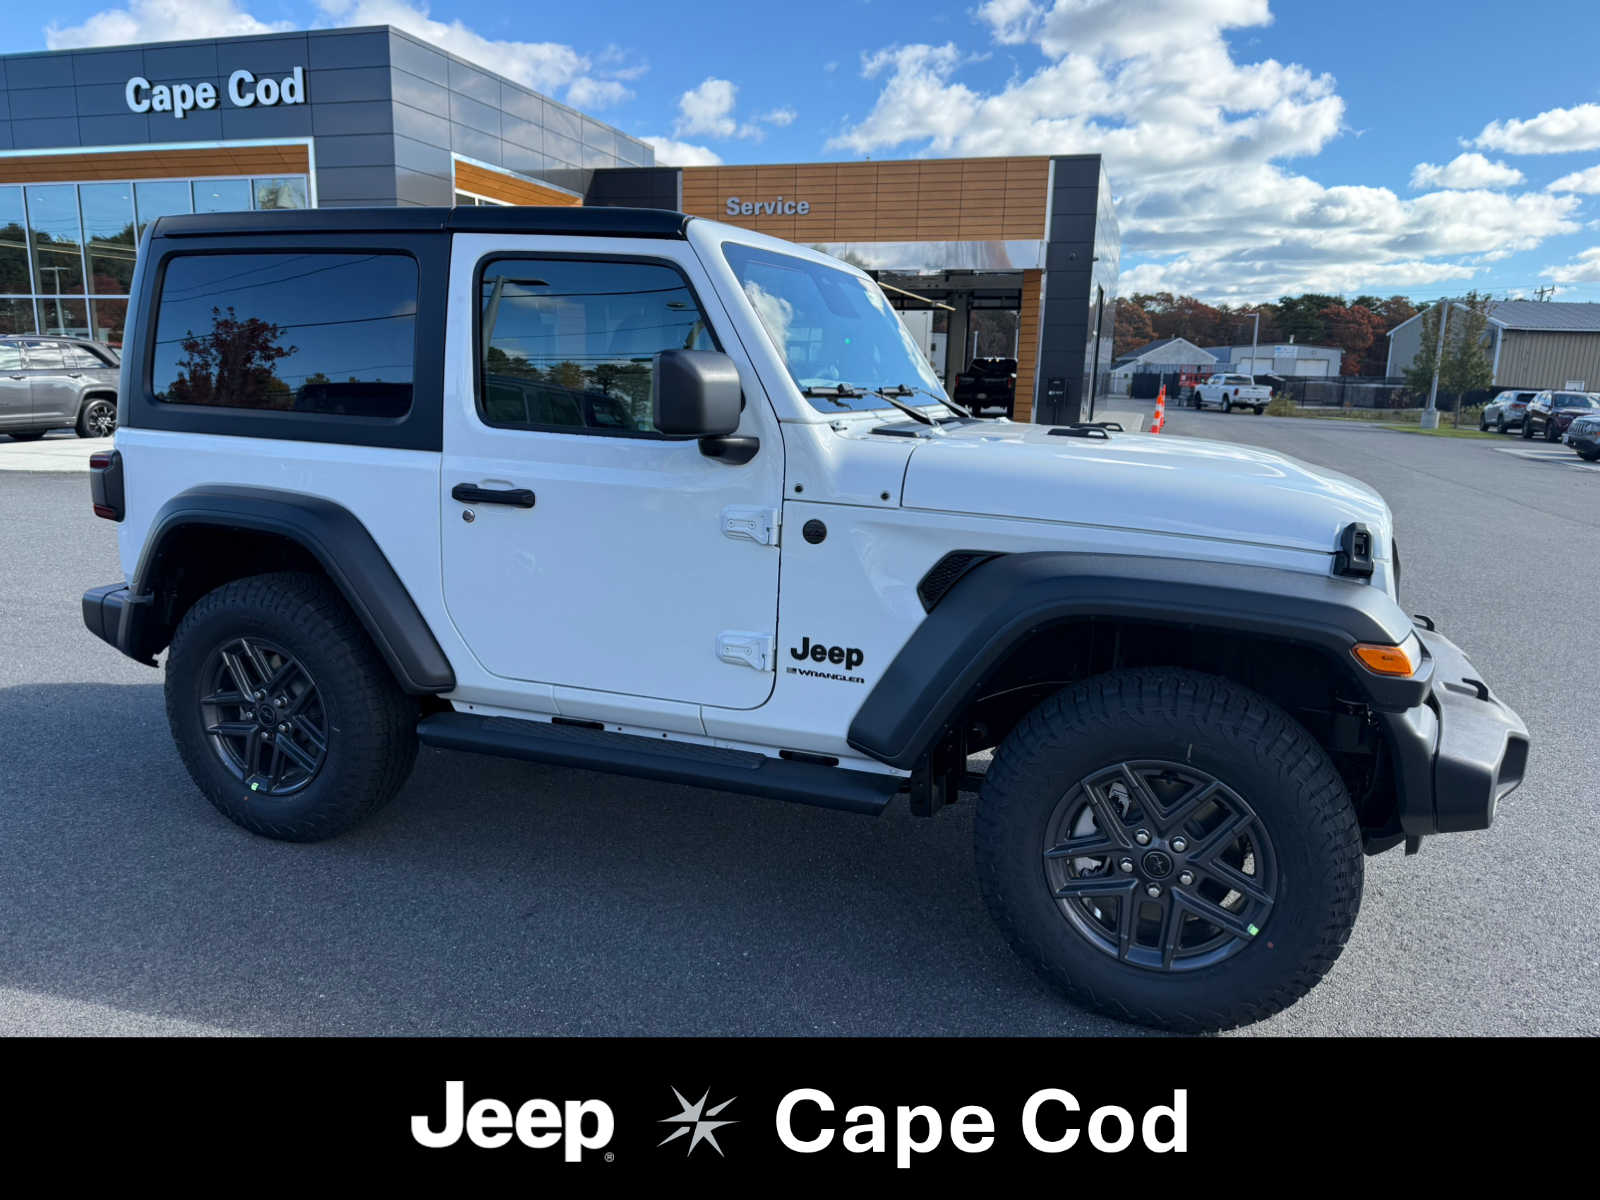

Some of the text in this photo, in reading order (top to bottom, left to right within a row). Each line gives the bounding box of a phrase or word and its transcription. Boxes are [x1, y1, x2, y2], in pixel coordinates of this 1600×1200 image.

[125, 66, 306, 119] Cape Cod
[726, 196, 810, 216] Service
[790, 636, 865, 671] Jeep
[798, 668, 865, 684] WRANGLER
